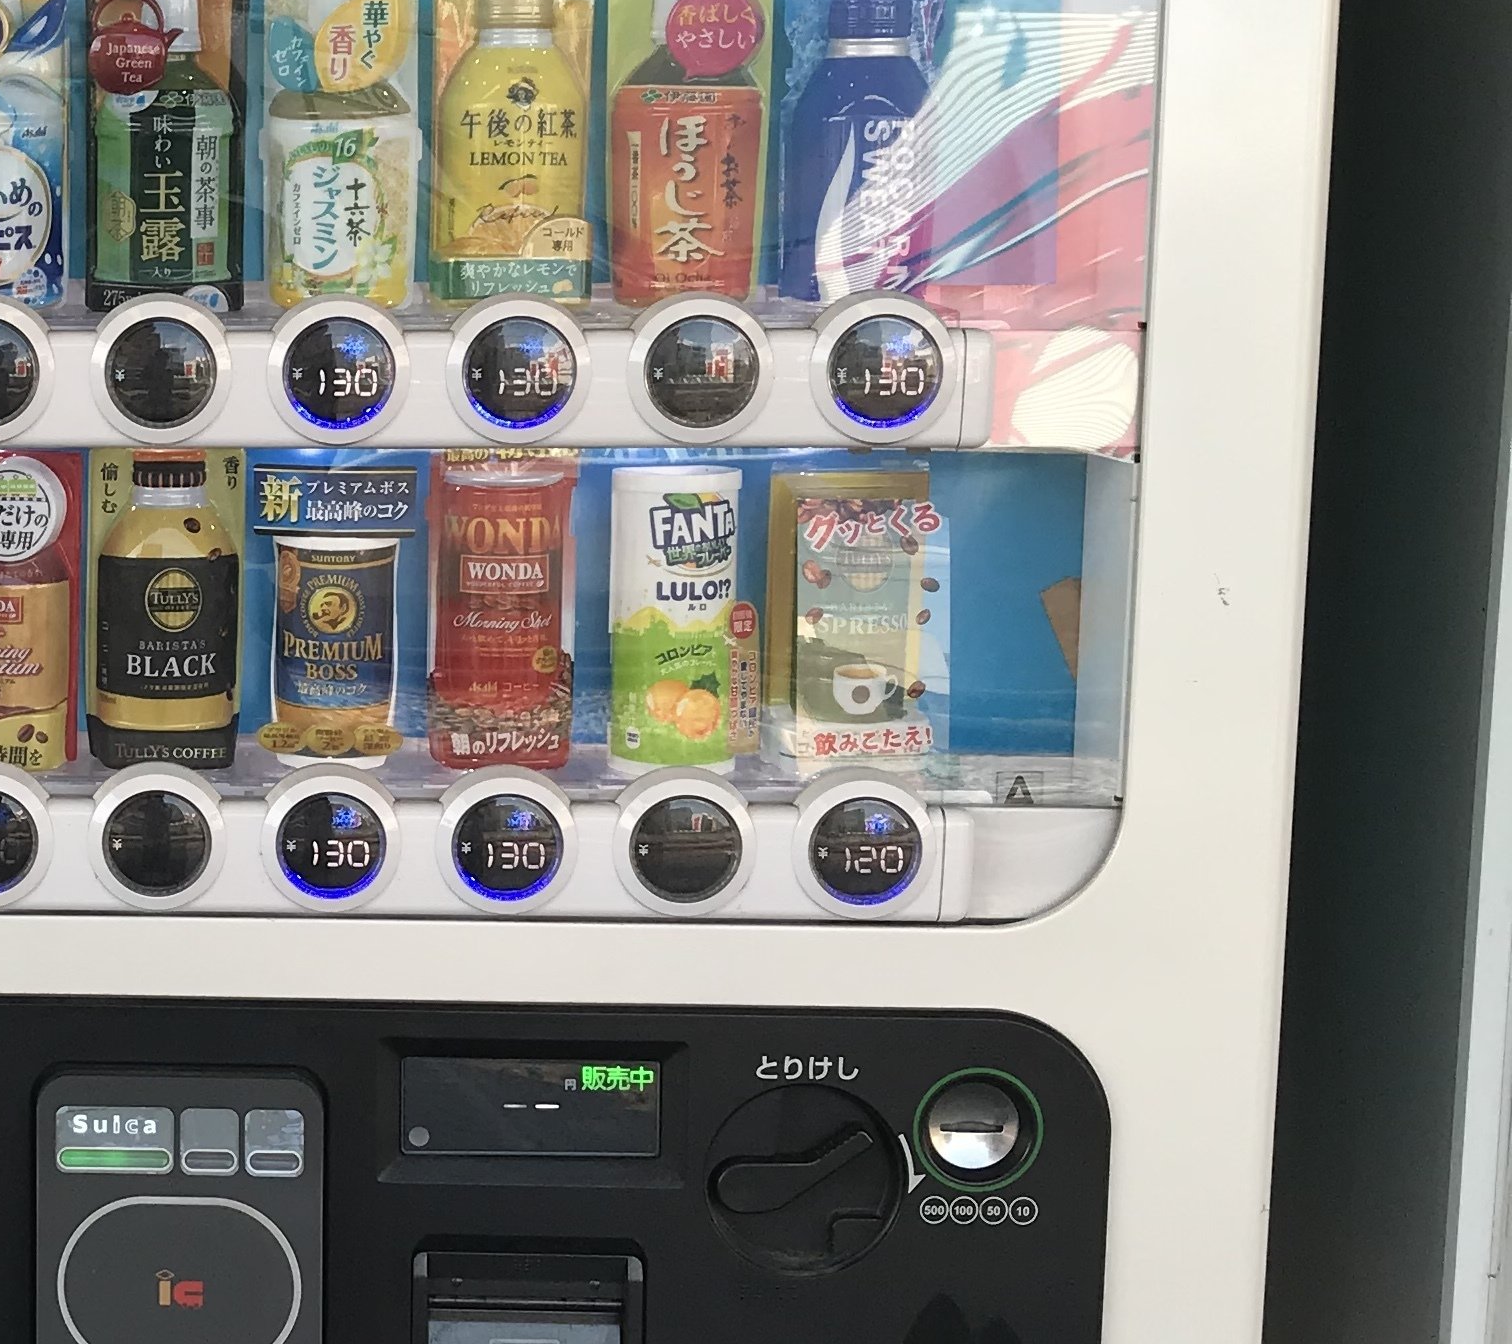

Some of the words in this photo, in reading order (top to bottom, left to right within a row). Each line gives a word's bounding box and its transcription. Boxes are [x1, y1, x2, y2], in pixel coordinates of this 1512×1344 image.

[676, 4, 757, 27] 香ばしく
[105, 42, 161, 58] Japanese
[328, 23, 357, 81] 香り
[675, 28, 756, 50] やさしい
[114, 56, 154, 71] Green
[121, 70, 144, 84] Tea
[459, 108, 578, 139] 午後の紅茶
[469, 151, 534, 167] LEMON
[537, 151, 568, 167] TEA
[193, 134, 218, 232] 朝の茶事
[654, 115, 726, 262] ほうじ茶
[139, 169, 186, 264] 玉露
[317, 367, 379, 398] 130
[259, 474, 303, 523] 新
[306, 479, 412, 496] プレミアムボス
[305, 499, 409, 522] 最高峰のコク
[651, 502, 736, 548] FANTA
[804, 501, 942, 552] グッとくる
[467, 560, 544, 582] WONDA
[282, 629, 384, 662] PREMIUM
[125, 652, 217, 679] BLACK
[304, 661, 359, 682] BOSS
[311, 839, 370, 868] 130
[485, 841, 546, 870] 130
[581, 1064, 655, 1093] 販売中
[755, 1055, 860, 1082] とりけし
[72, 1114, 158, 1135] Suica
[923, 1204, 946, 1217] 500
[952, 1204, 975, 1217] 100
[986, 1205, 1001, 1217] 50
[1015, 1205, 1031, 1217] 10
